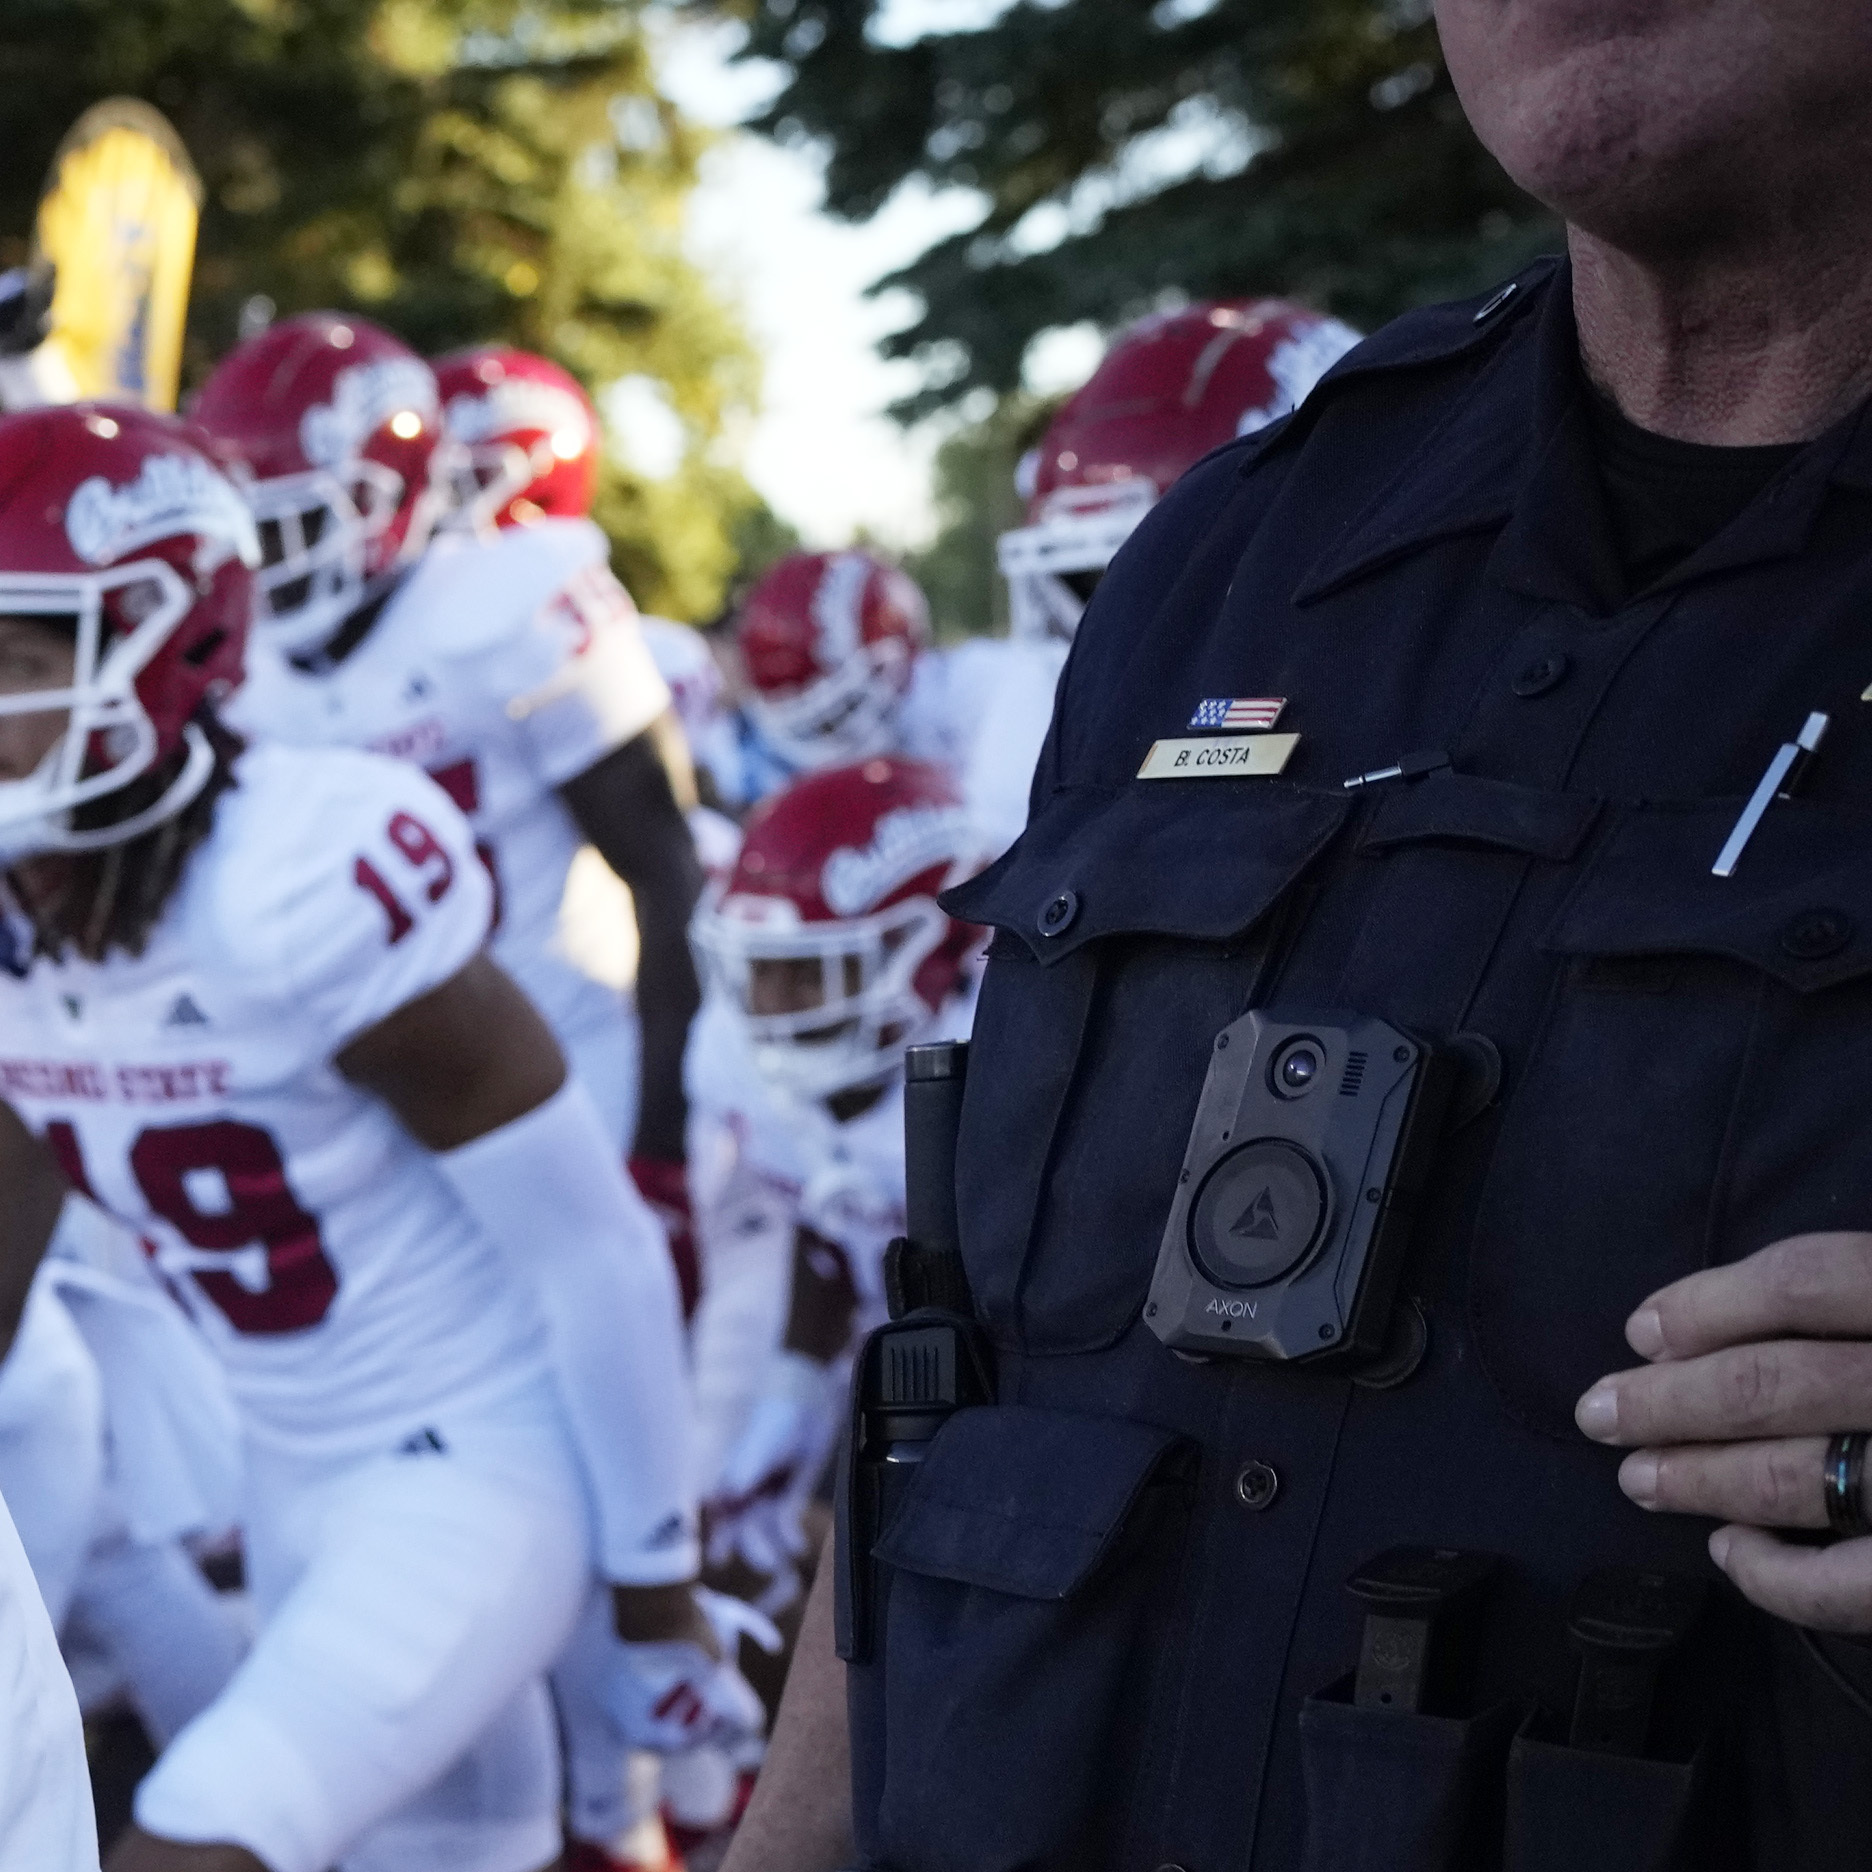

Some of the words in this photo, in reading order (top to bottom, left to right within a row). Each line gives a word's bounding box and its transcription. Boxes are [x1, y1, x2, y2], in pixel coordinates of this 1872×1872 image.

[1196, 747, 1251, 766] COSTA
[353, 810, 456, 945] 19
[1205, 1297, 1258, 1319] AXON
